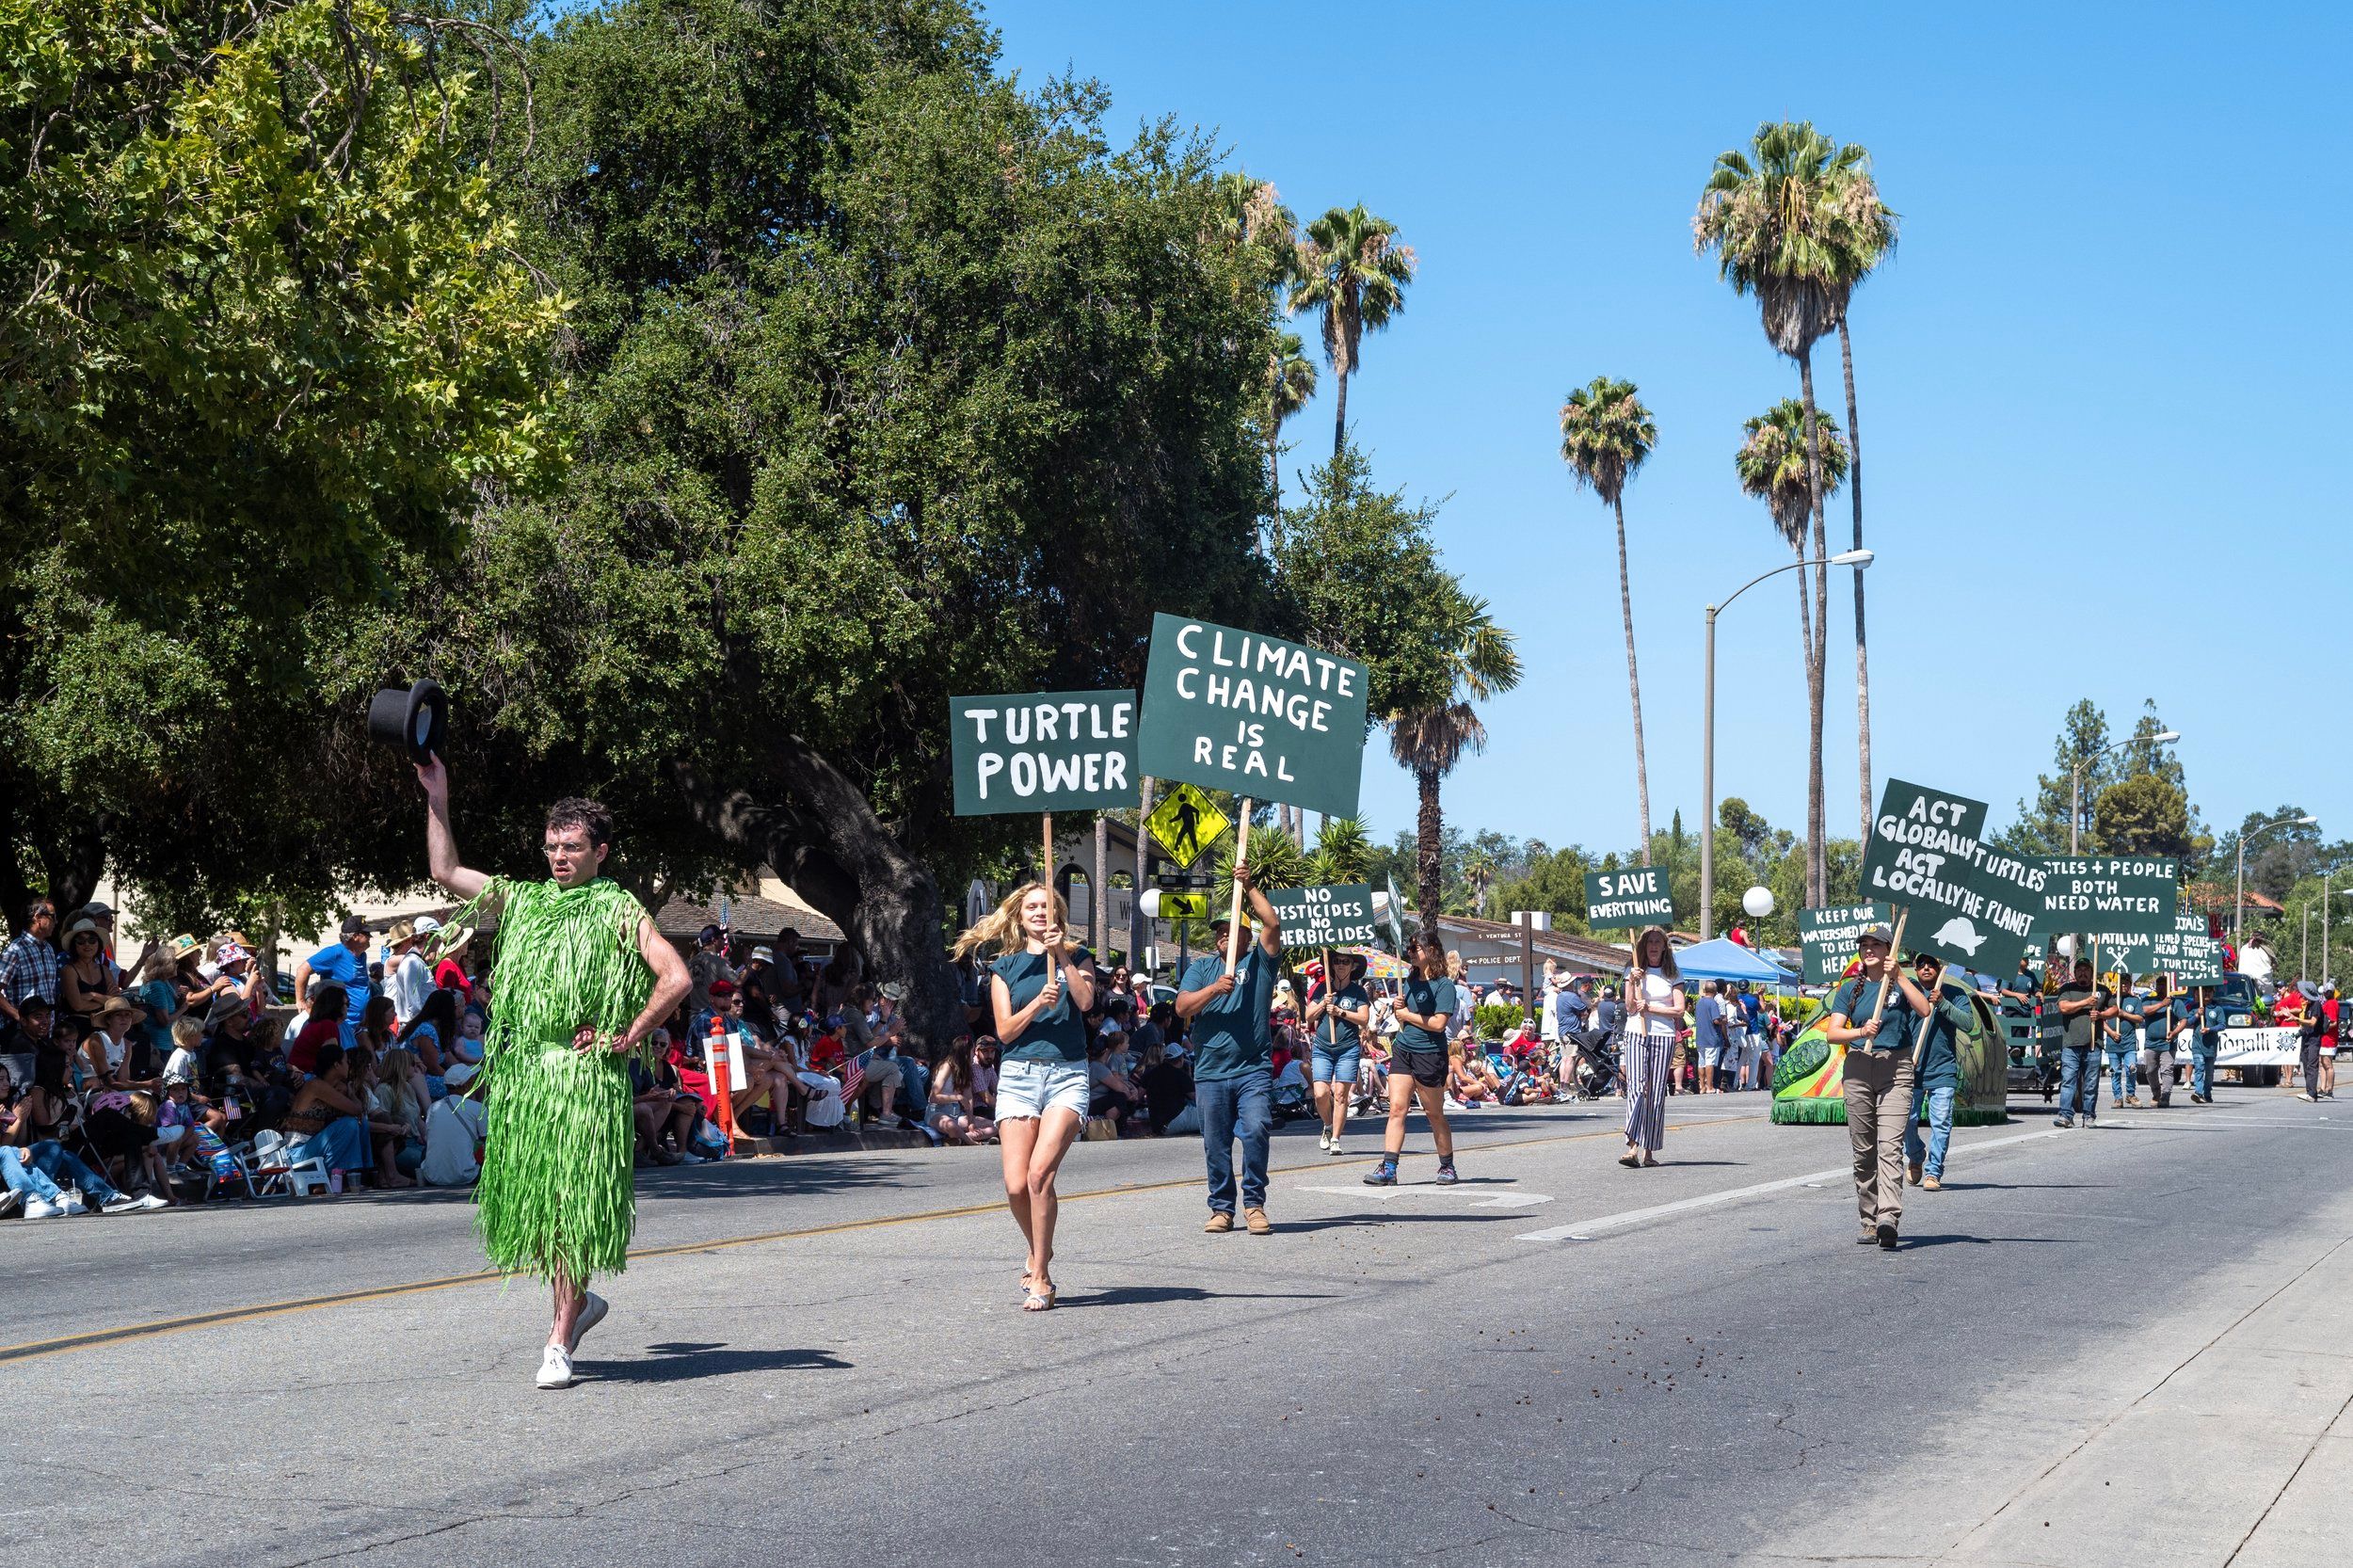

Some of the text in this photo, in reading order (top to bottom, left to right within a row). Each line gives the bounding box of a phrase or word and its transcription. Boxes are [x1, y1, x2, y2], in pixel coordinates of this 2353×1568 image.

[1176, 624, 1357, 698] CLIMATE
[1176, 666, 1333, 733] CHANGE
[964, 702, 1132, 744] TURTLE
[1237, 720, 1265, 748] IS
[1193, 736, 1295, 782] REAL
[977, 750, 1128, 800] POWER
[1907, 795, 1966, 827] ACT
[1878, 814, 1977, 861] GLOBALLY
[1895, 847, 1946, 877] ACT
[1974, 847, 2047, 892] TURTLES
[2109, 860, 2174, 879] PEOPLE
[1304, 888, 1332, 904] NO
[1598, 872, 1657, 897] SAVE
[1872, 865, 1966, 907] LOCALLY
[2072, 879, 2118, 895] BOTH
[1589, 898, 1673, 919] EVERYTHING
[1816, 906, 1876, 925] KEEP OUR
[1961, 889, 2035, 938] HE PLANET
[2044, 895, 2160, 914] NEED WATER
[1310, 918, 1331, 929] NO
[1801, 924, 1860, 944] WATERSHED
[1819, 942, 1835, 953] TO
[2087, 932, 2150, 947] MATILIJA
[1821, 955, 1853, 975] HEA
[2161, 957, 2207, 972] TURTLES
